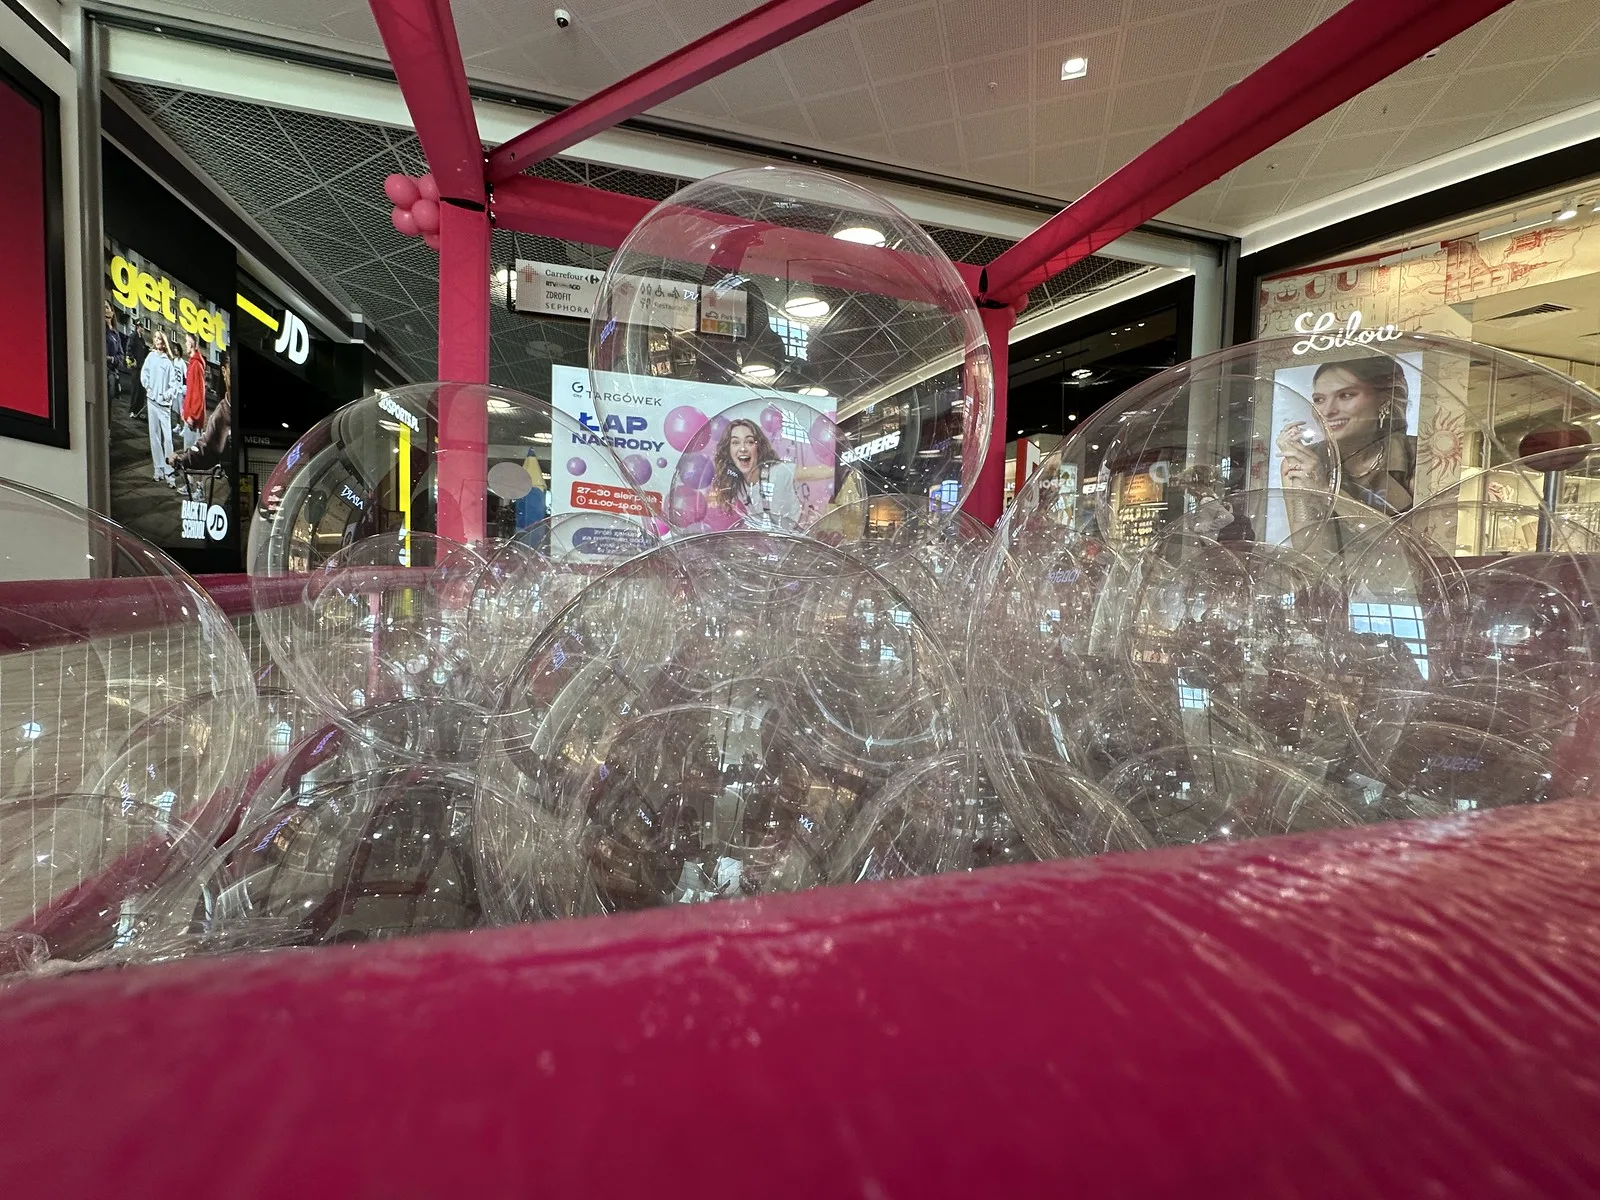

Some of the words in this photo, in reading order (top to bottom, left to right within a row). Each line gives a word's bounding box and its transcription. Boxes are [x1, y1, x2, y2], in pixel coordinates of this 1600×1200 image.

[545, 269, 583, 281] Carrefour
[111, 255, 176, 323] get
[179, 297, 226, 351] set
[546, 291, 572, 301] ZDROFIT
[545, 303, 589, 313] SEPHORA
[275, 309, 309, 365] JD
[1292, 310, 1403, 355] Lilou
[586, 390, 662, 406] TARGÓWEK
[579, 412, 648, 434] ŁAP
[244, 435, 271, 445] MENS
[572, 433, 665, 452] NAGRODY
[840, 430, 901, 466] SKECHERS
[210, 514, 225, 531] JD
